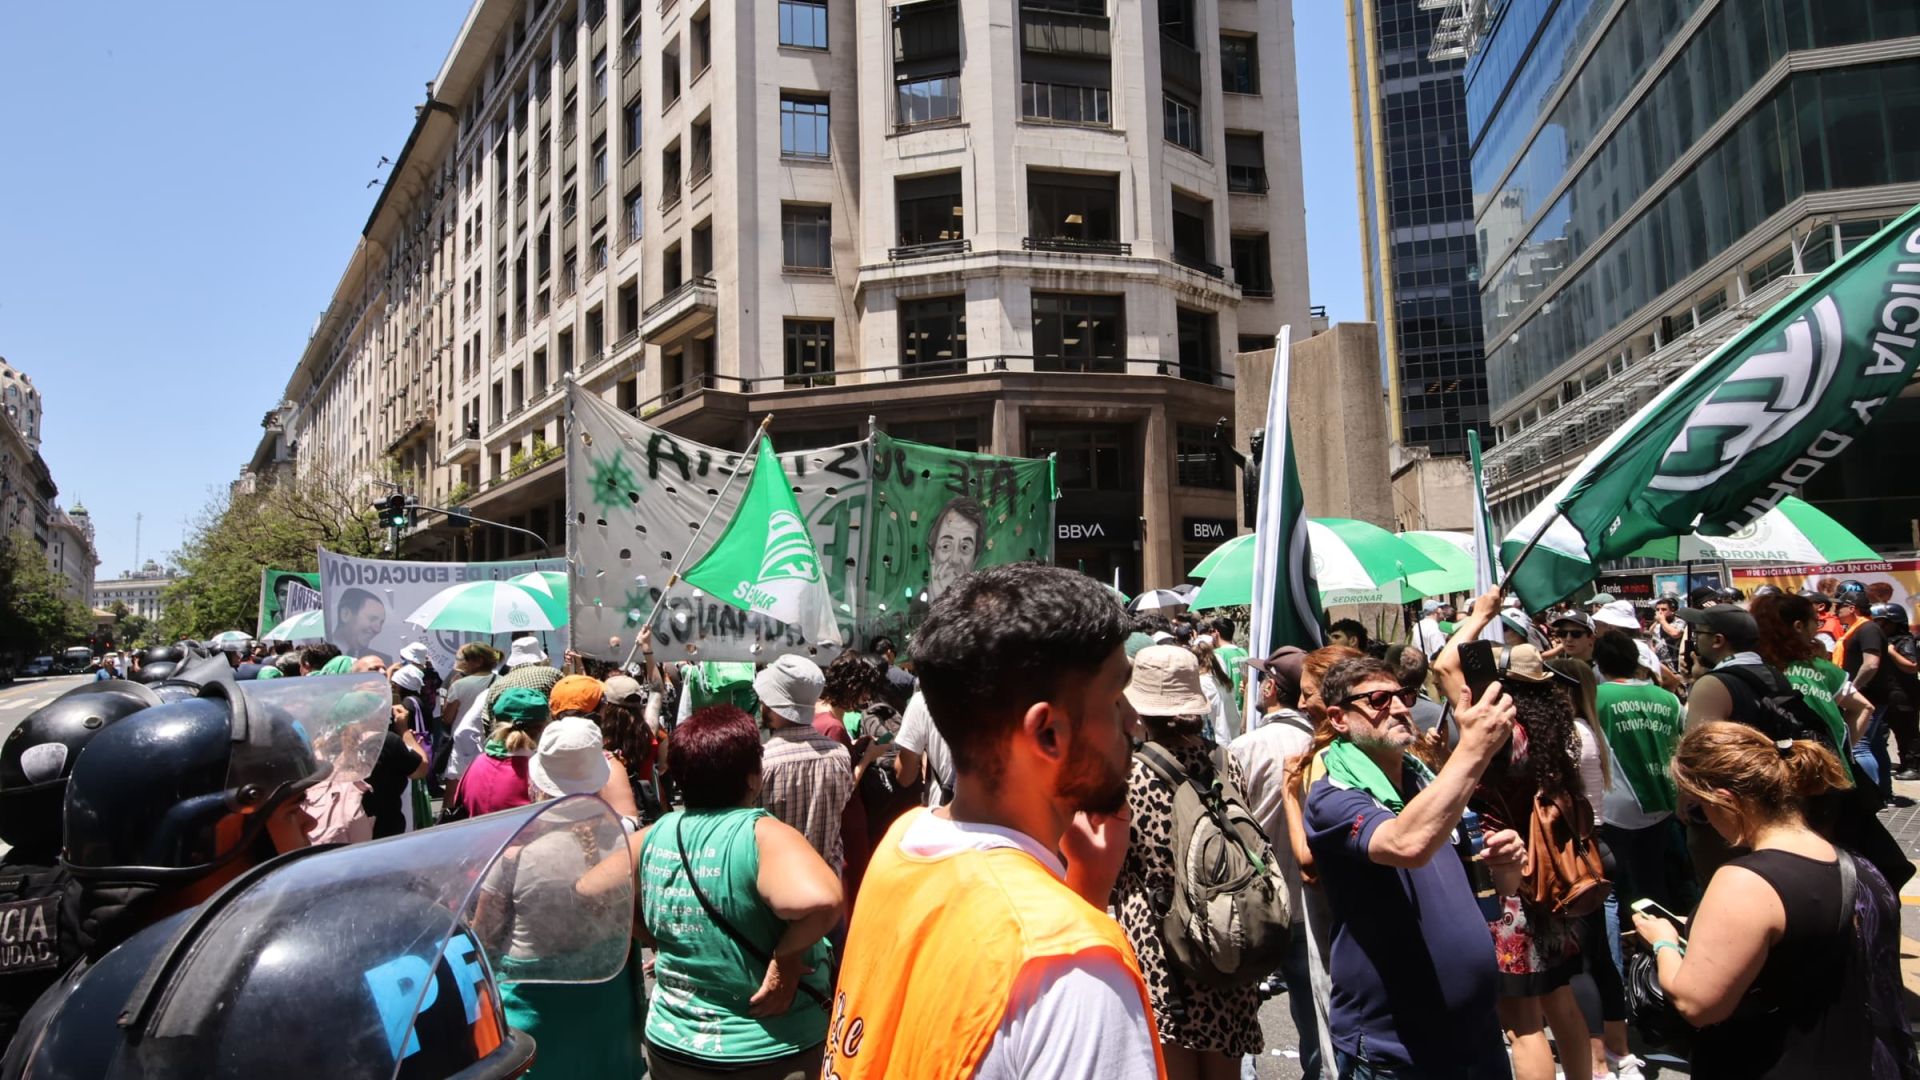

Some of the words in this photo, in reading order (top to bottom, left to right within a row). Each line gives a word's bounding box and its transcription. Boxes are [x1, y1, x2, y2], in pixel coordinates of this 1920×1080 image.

[1851, 396, 1887, 425] Y
[1058, 523, 1105, 539] BBVA
[1194, 523, 1225, 538] BBVA
[1699, 549, 1790, 560] SEDRONAR
[1762, 567, 1807, 577] DICIEMBRE
[1848, 563, 1861, 572] EN
[1863, 562, 1893, 571] CINES
[1331, 594, 1384, 604] SEDRONAR
[1611, 700, 1640, 715] TODOS
